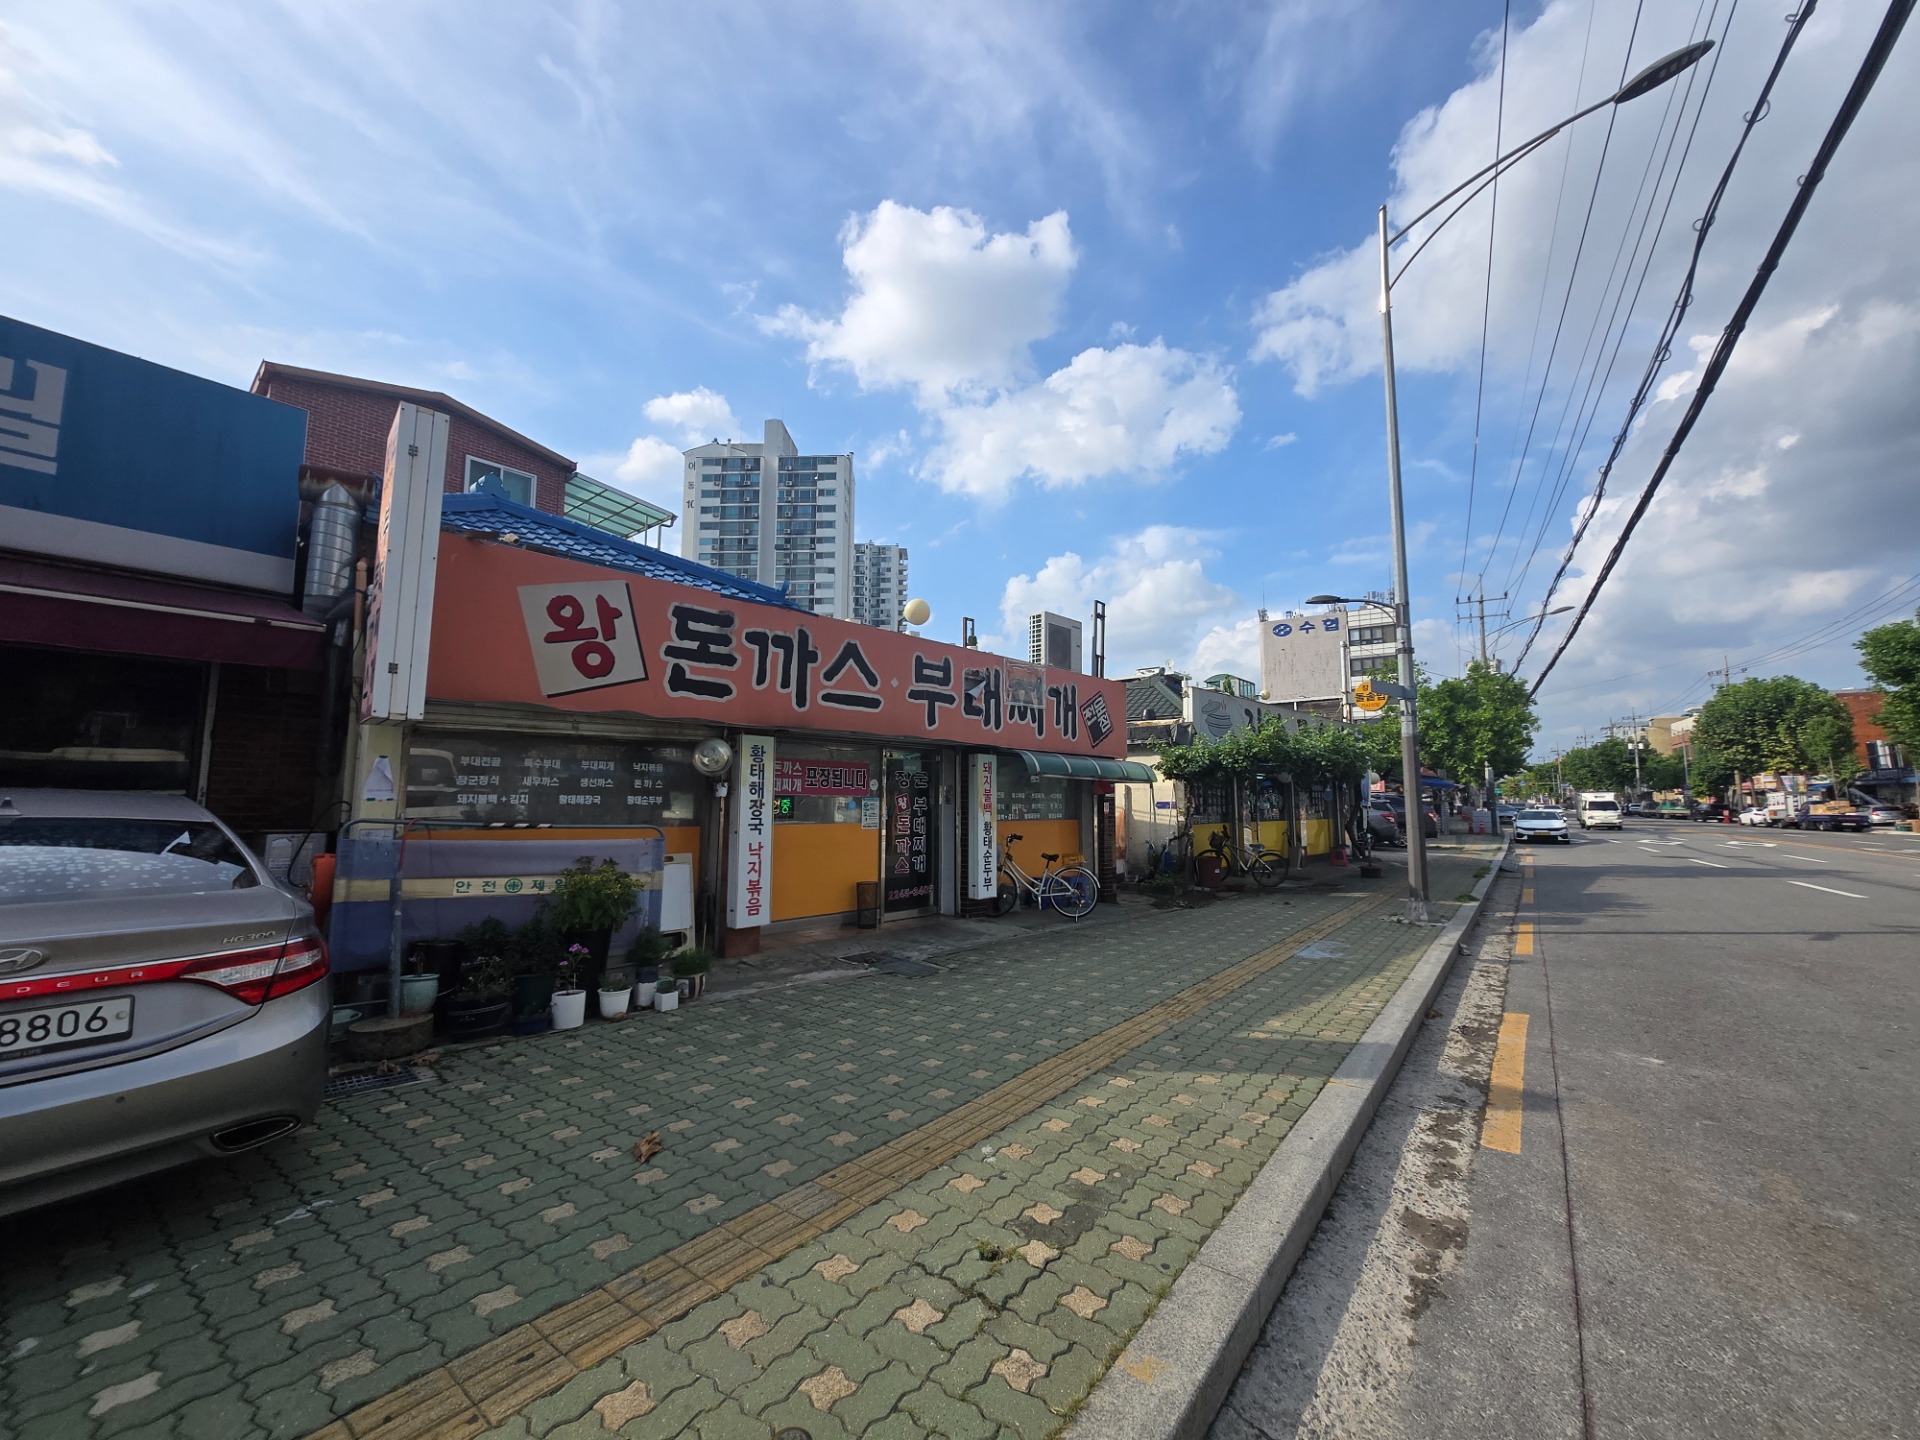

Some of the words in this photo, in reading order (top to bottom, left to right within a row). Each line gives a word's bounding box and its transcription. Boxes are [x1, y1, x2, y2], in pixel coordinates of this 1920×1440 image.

[1298, 617, 1340, 634] 수협
[543, 594, 623, 679] 왕
[661, 602, 883, 712] 돈까스
[456, 775, 499, 786] 장군정식
[522, 776, 560, 787] 새우까스
[579, 778, 614, 788] 생선까스
[460, 756, 501, 768] 부대전골
[580, 760, 615, 772] 부대찌개
[632, 762, 664, 773] 낙지볶음
[804, 766, 868, 790] 포장됩니다
[895, 770, 928, 788] 장군
[456, 794, 498, 805] 돼지불백
[509, 794, 529, 805] 김치
[558, 795, 602, 805] 황태해장국
[626, 795, 663, 805] 황태순두부
[747, 744, 766, 835] 황태해장국
[982, 761, 993, 817] 돼지불백
[895, 815, 911, 874] 돈까스
[912, 796, 928, 873] 부대찌개
[982, 822, 993, 891] 황태순두부
[455, 879, 498, 895] 안전
[745, 842, 764, 916] 낙지볶음
[0, 1005, 109, 1047] 8806
